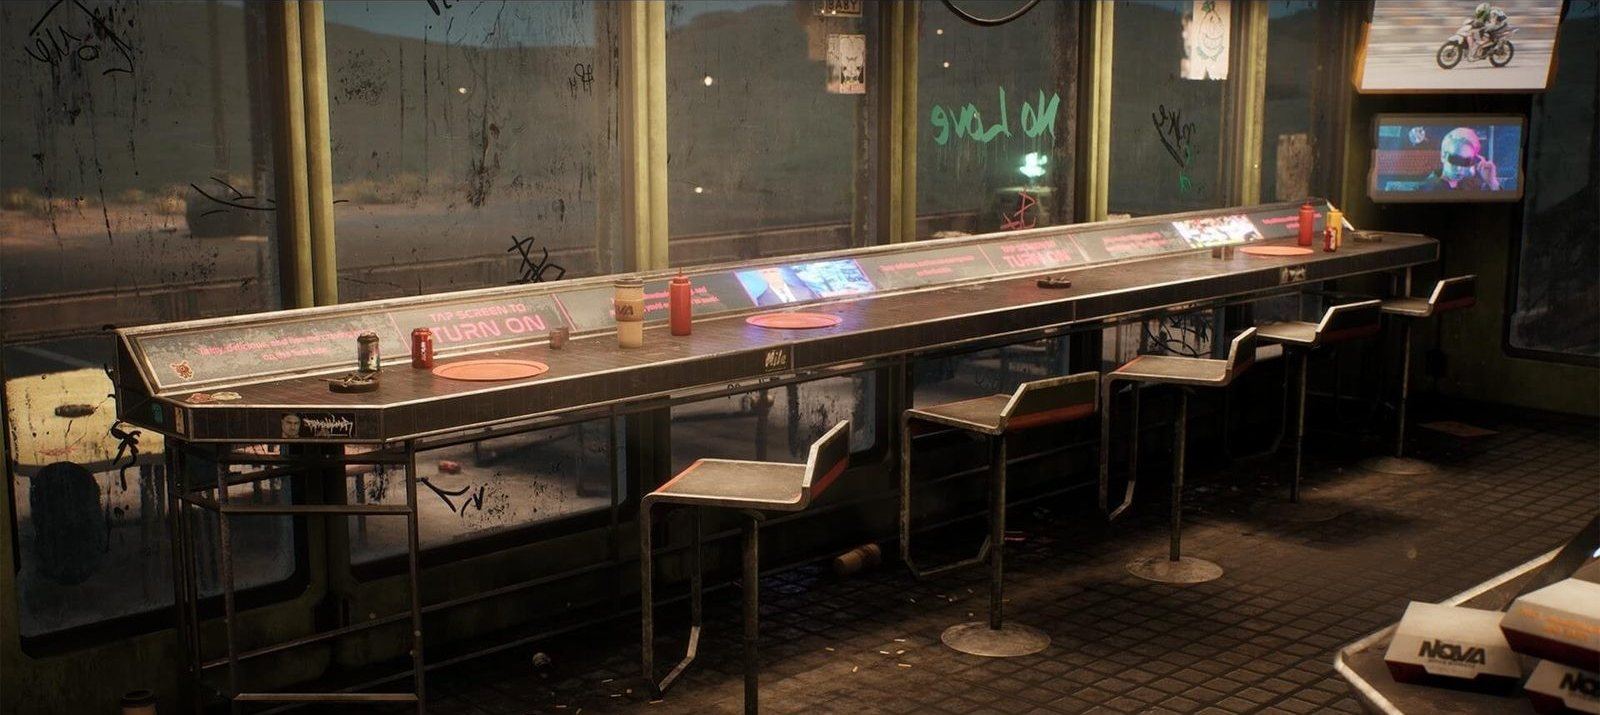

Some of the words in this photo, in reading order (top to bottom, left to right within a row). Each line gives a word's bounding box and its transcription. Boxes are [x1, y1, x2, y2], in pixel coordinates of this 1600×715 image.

[430, 311, 454, 322] TAP
[456, 304, 508, 319] SCREEN
[508, 303, 526, 313] TO
[615, 303, 634, 316] VA
[428, 320, 501, 342] TURN
[505, 314, 546, 333] ON
[1418, 639, 1486, 665] NOVA
[1560, 673, 1600, 696] NO
